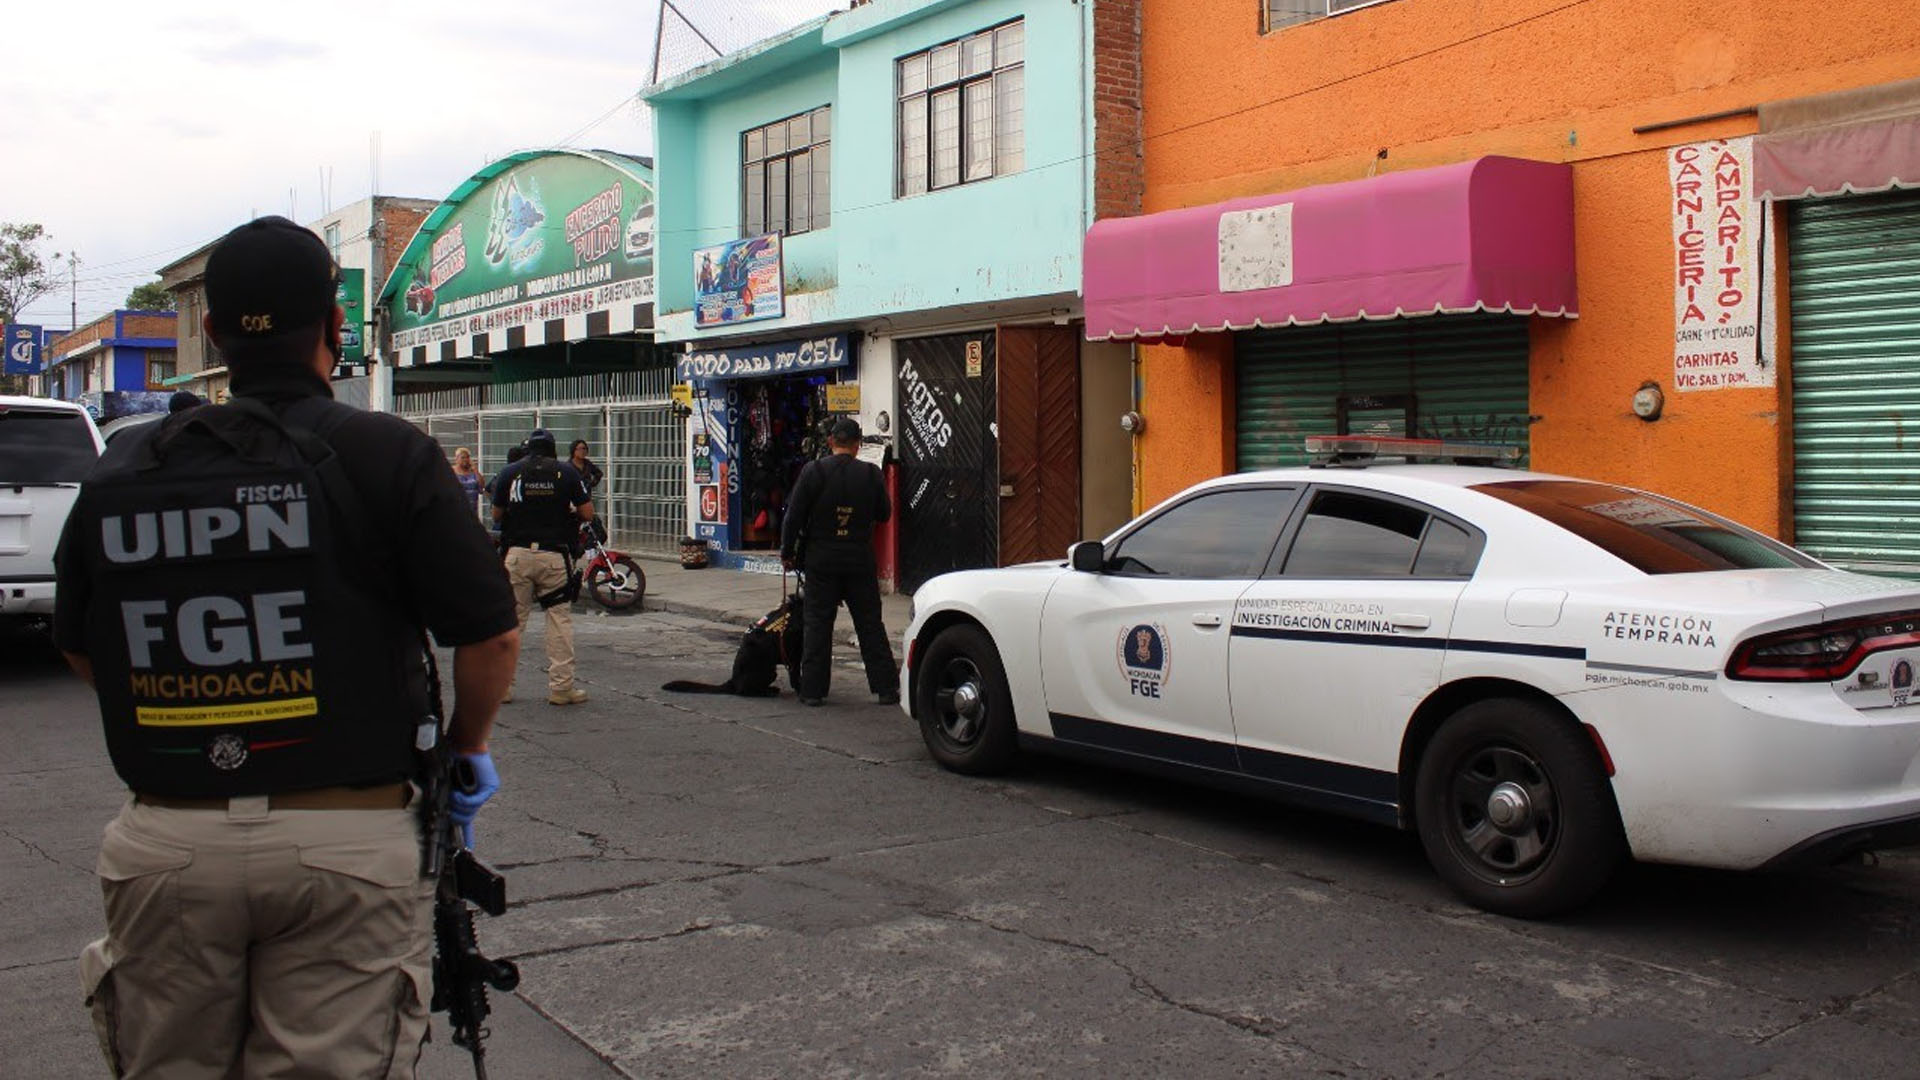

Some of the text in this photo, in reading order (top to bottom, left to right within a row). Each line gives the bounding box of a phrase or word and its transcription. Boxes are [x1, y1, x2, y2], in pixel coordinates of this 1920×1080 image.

[575, 216, 620, 267] PULIDO
[1674, 146, 1705, 325] CARNICERIA
[241, 314, 273, 331] COE
[1676, 329, 1702, 343] CARNE
[1719, 326, 1755, 339] CALIDAD
[680, 353, 730, 377] TODO
[734, 355, 771, 374] PARA
[798, 337, 844, 366] CEL
[1676, 351, 1738, 368] CARNITAS
[899, 358, 952, 448] MOTOS
[236, 483, 307, 503] FISCAL
[101, 501, 310, 563] UIPN
[1238, 597, 1384, 616] UNIDAD ESPECIALIZADA EN
[121, 590, 314, 668] FGE
[1237, 610, 1331, 629] INVESTIGACIÓN
[1604, 611, 1713, 632] ATENCIÓN
[1603, 625, 1716, 648] TEMPRANA
[130, 664, 313, 698] MICHOACÁN
[1130, 679, 1161, 699] FGE
